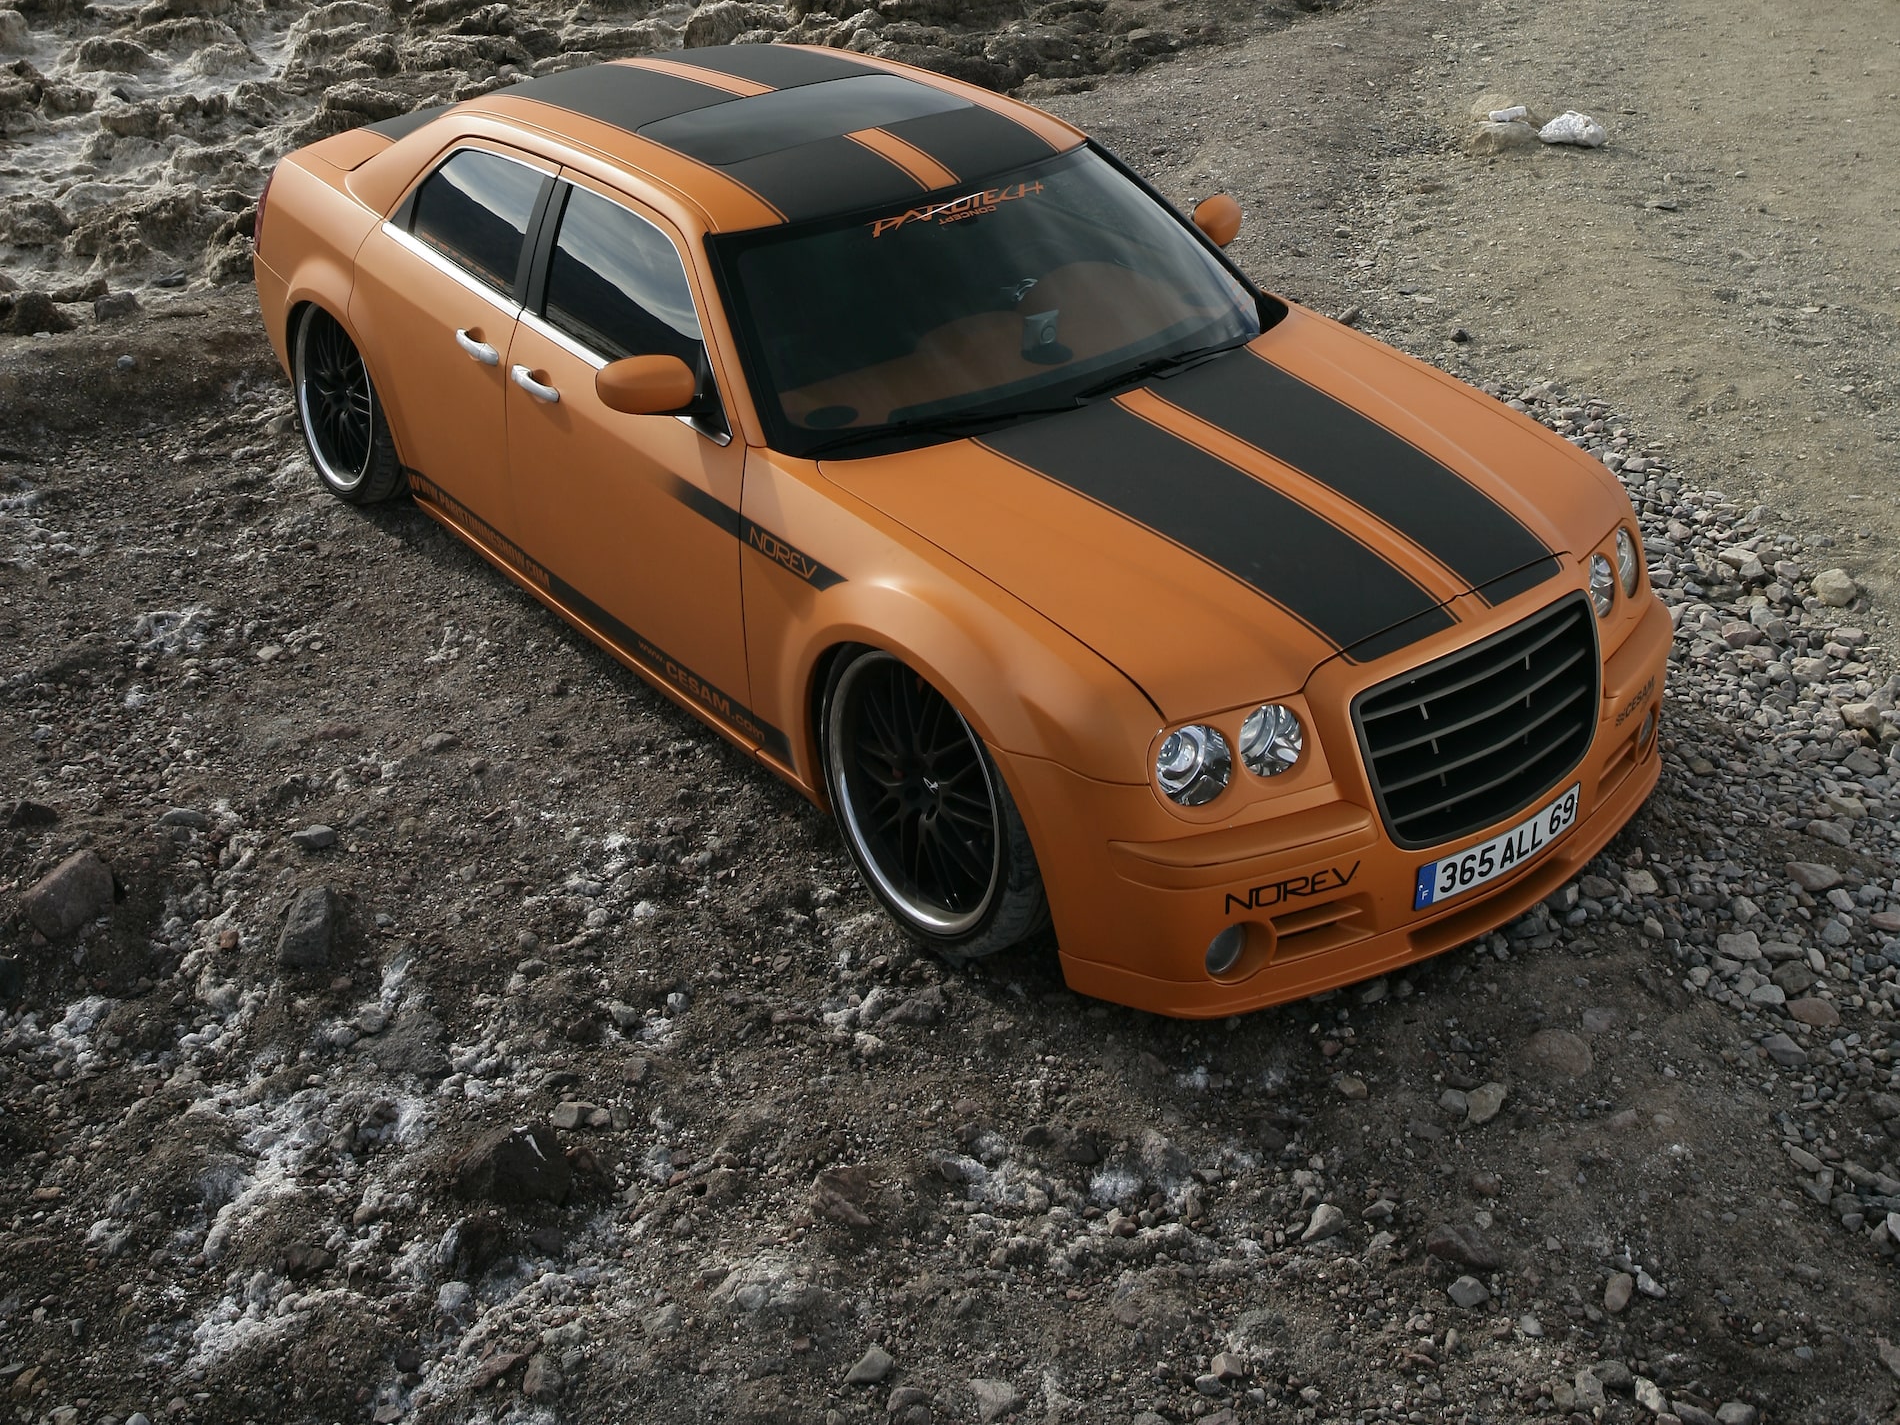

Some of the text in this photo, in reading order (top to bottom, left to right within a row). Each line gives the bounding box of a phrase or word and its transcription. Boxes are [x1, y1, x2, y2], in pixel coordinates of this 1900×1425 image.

[939, 205, 997, 225] CONCEPT
[750, 526, 817, 579] NOREV
[1440, 794, 1575, 893] 365 ALL 69
[1225, 860, 1361, 915] NOREV
[1421, 889, 1429, 901] F
